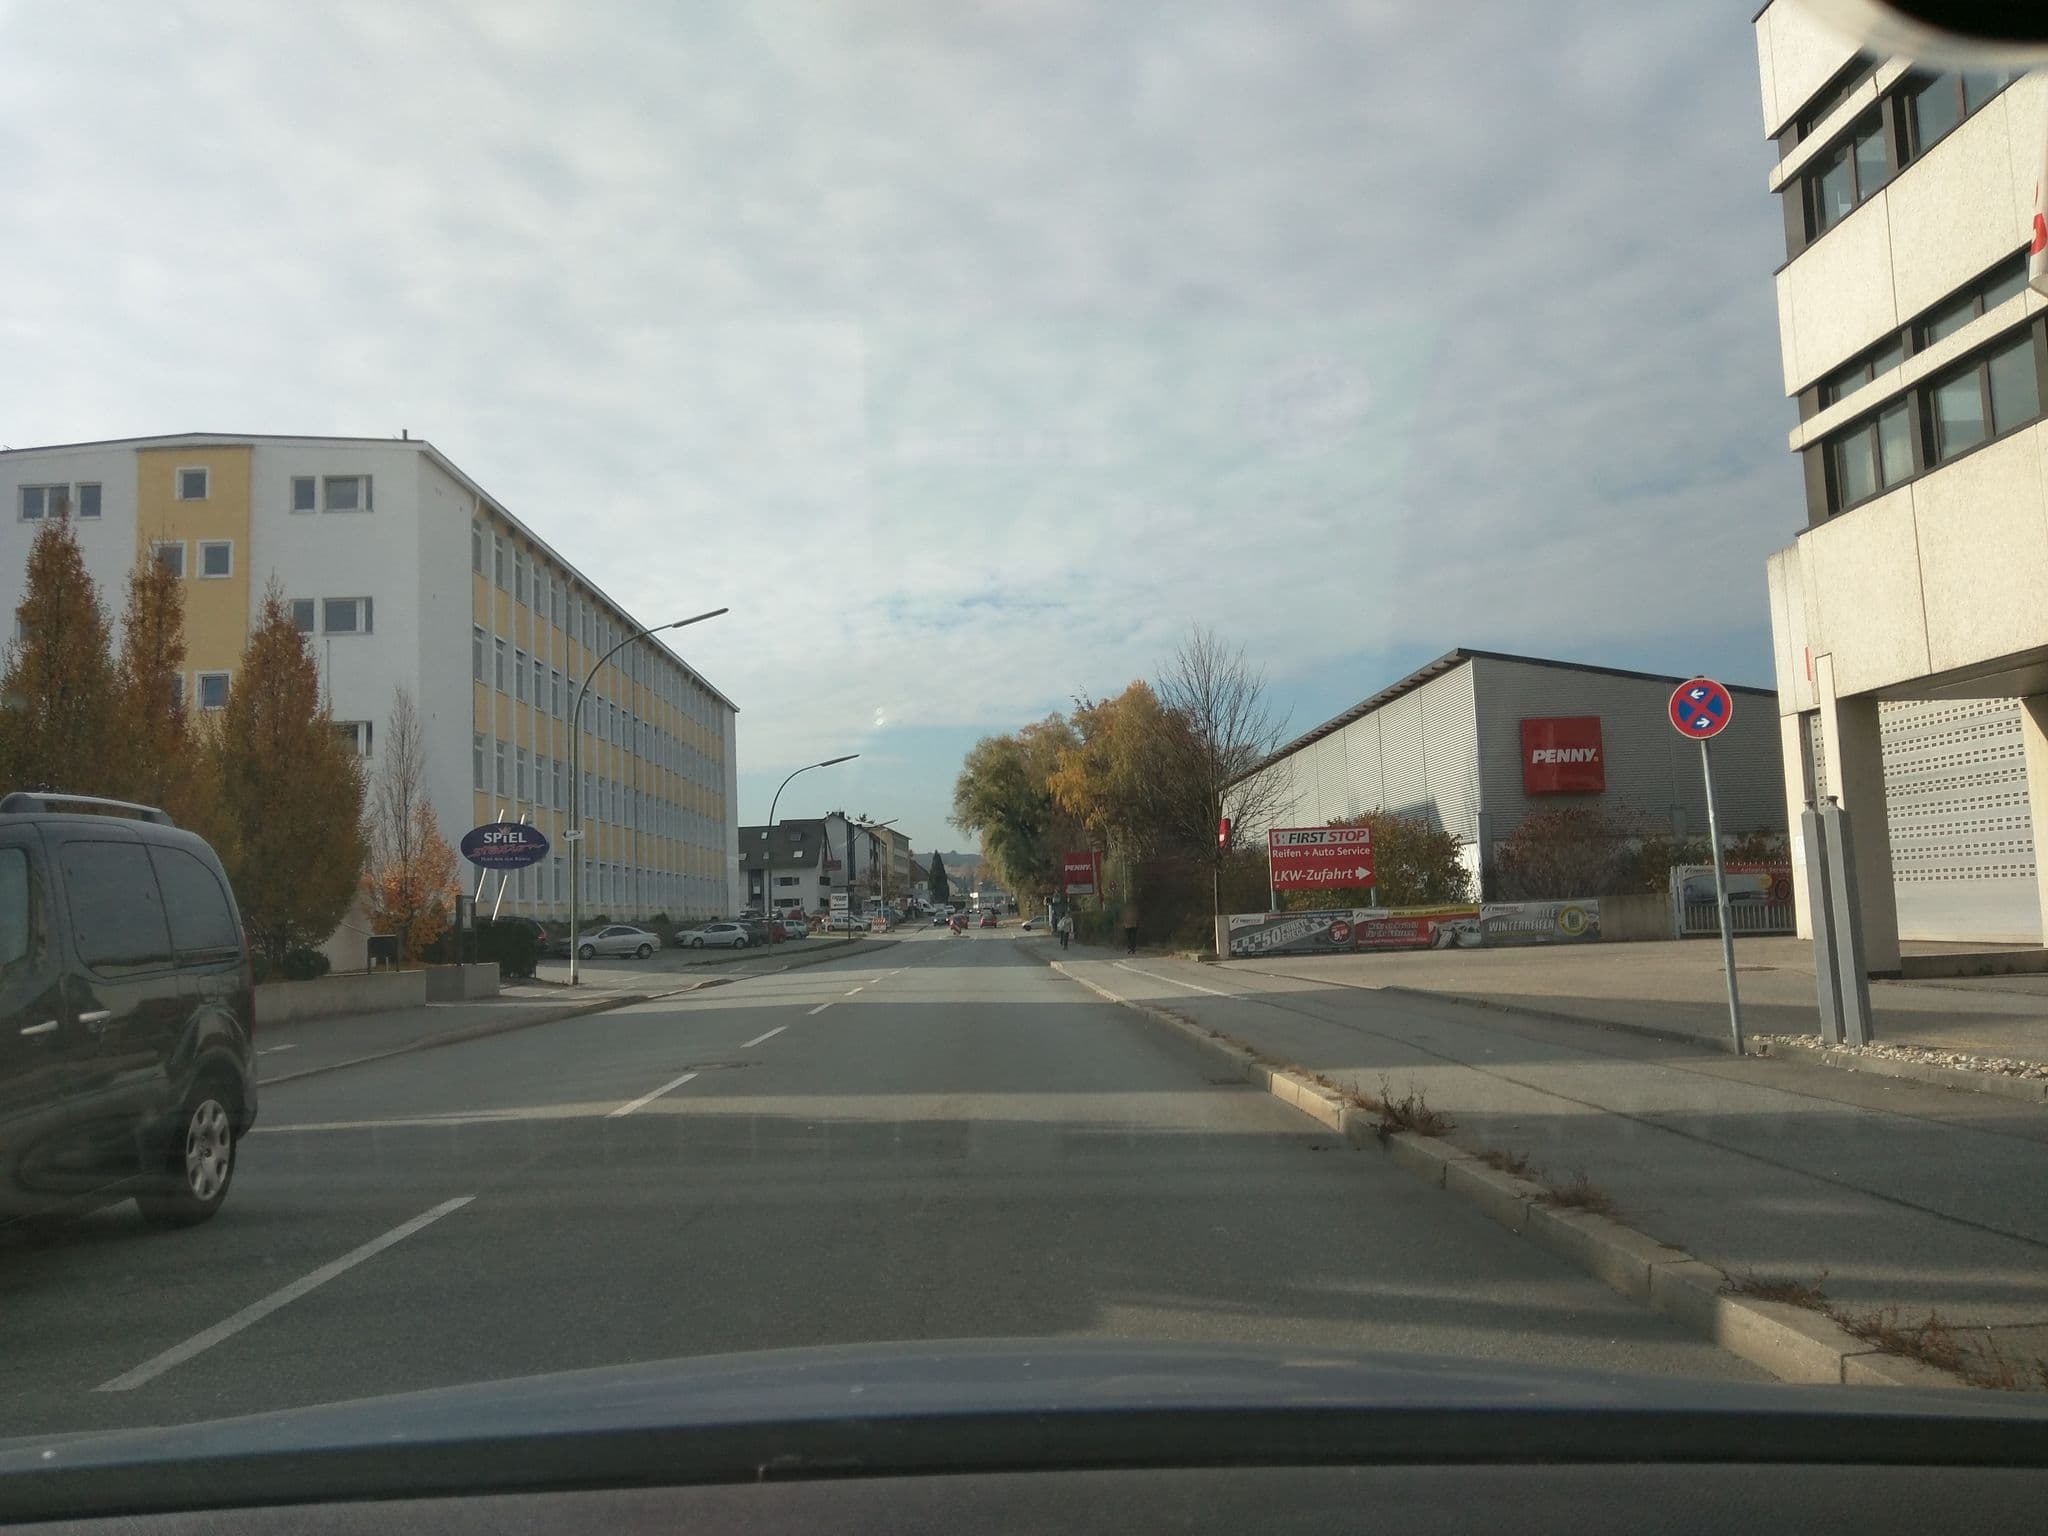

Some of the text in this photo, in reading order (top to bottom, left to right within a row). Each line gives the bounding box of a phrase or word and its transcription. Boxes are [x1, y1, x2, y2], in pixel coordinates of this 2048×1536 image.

[1288, 830, 1366, 844] FIRST STOP
[1272, 849, 1301, 858] Reifen
[1312, 848, 1335, 857] Auto
[1337, 846, 1371, 856] Service
[1274, 868, 1353, 883] LKW-Zufahrt
[1262, 928, 1281, 947] 50
